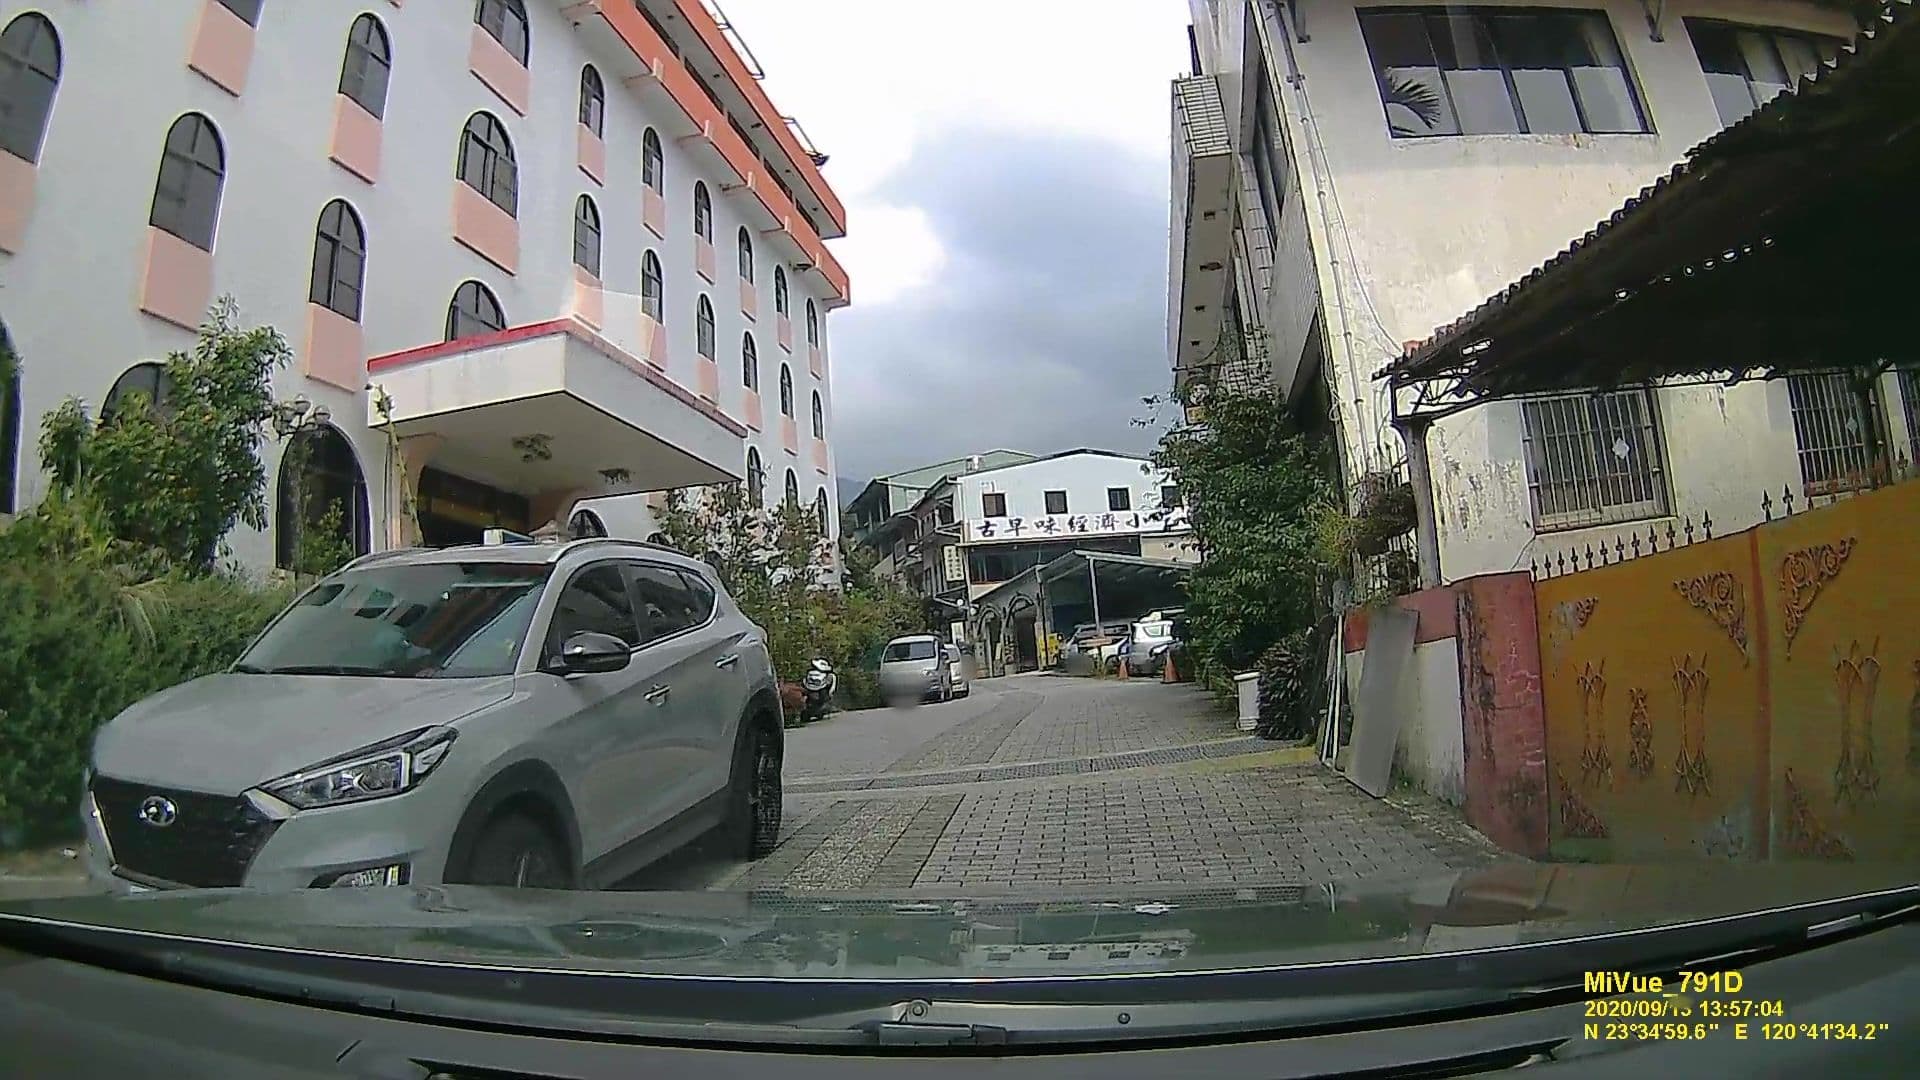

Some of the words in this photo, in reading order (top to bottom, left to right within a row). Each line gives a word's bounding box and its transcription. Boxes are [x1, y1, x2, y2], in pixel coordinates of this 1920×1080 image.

[975, 511, 1171, 538] 古早味經濟小
